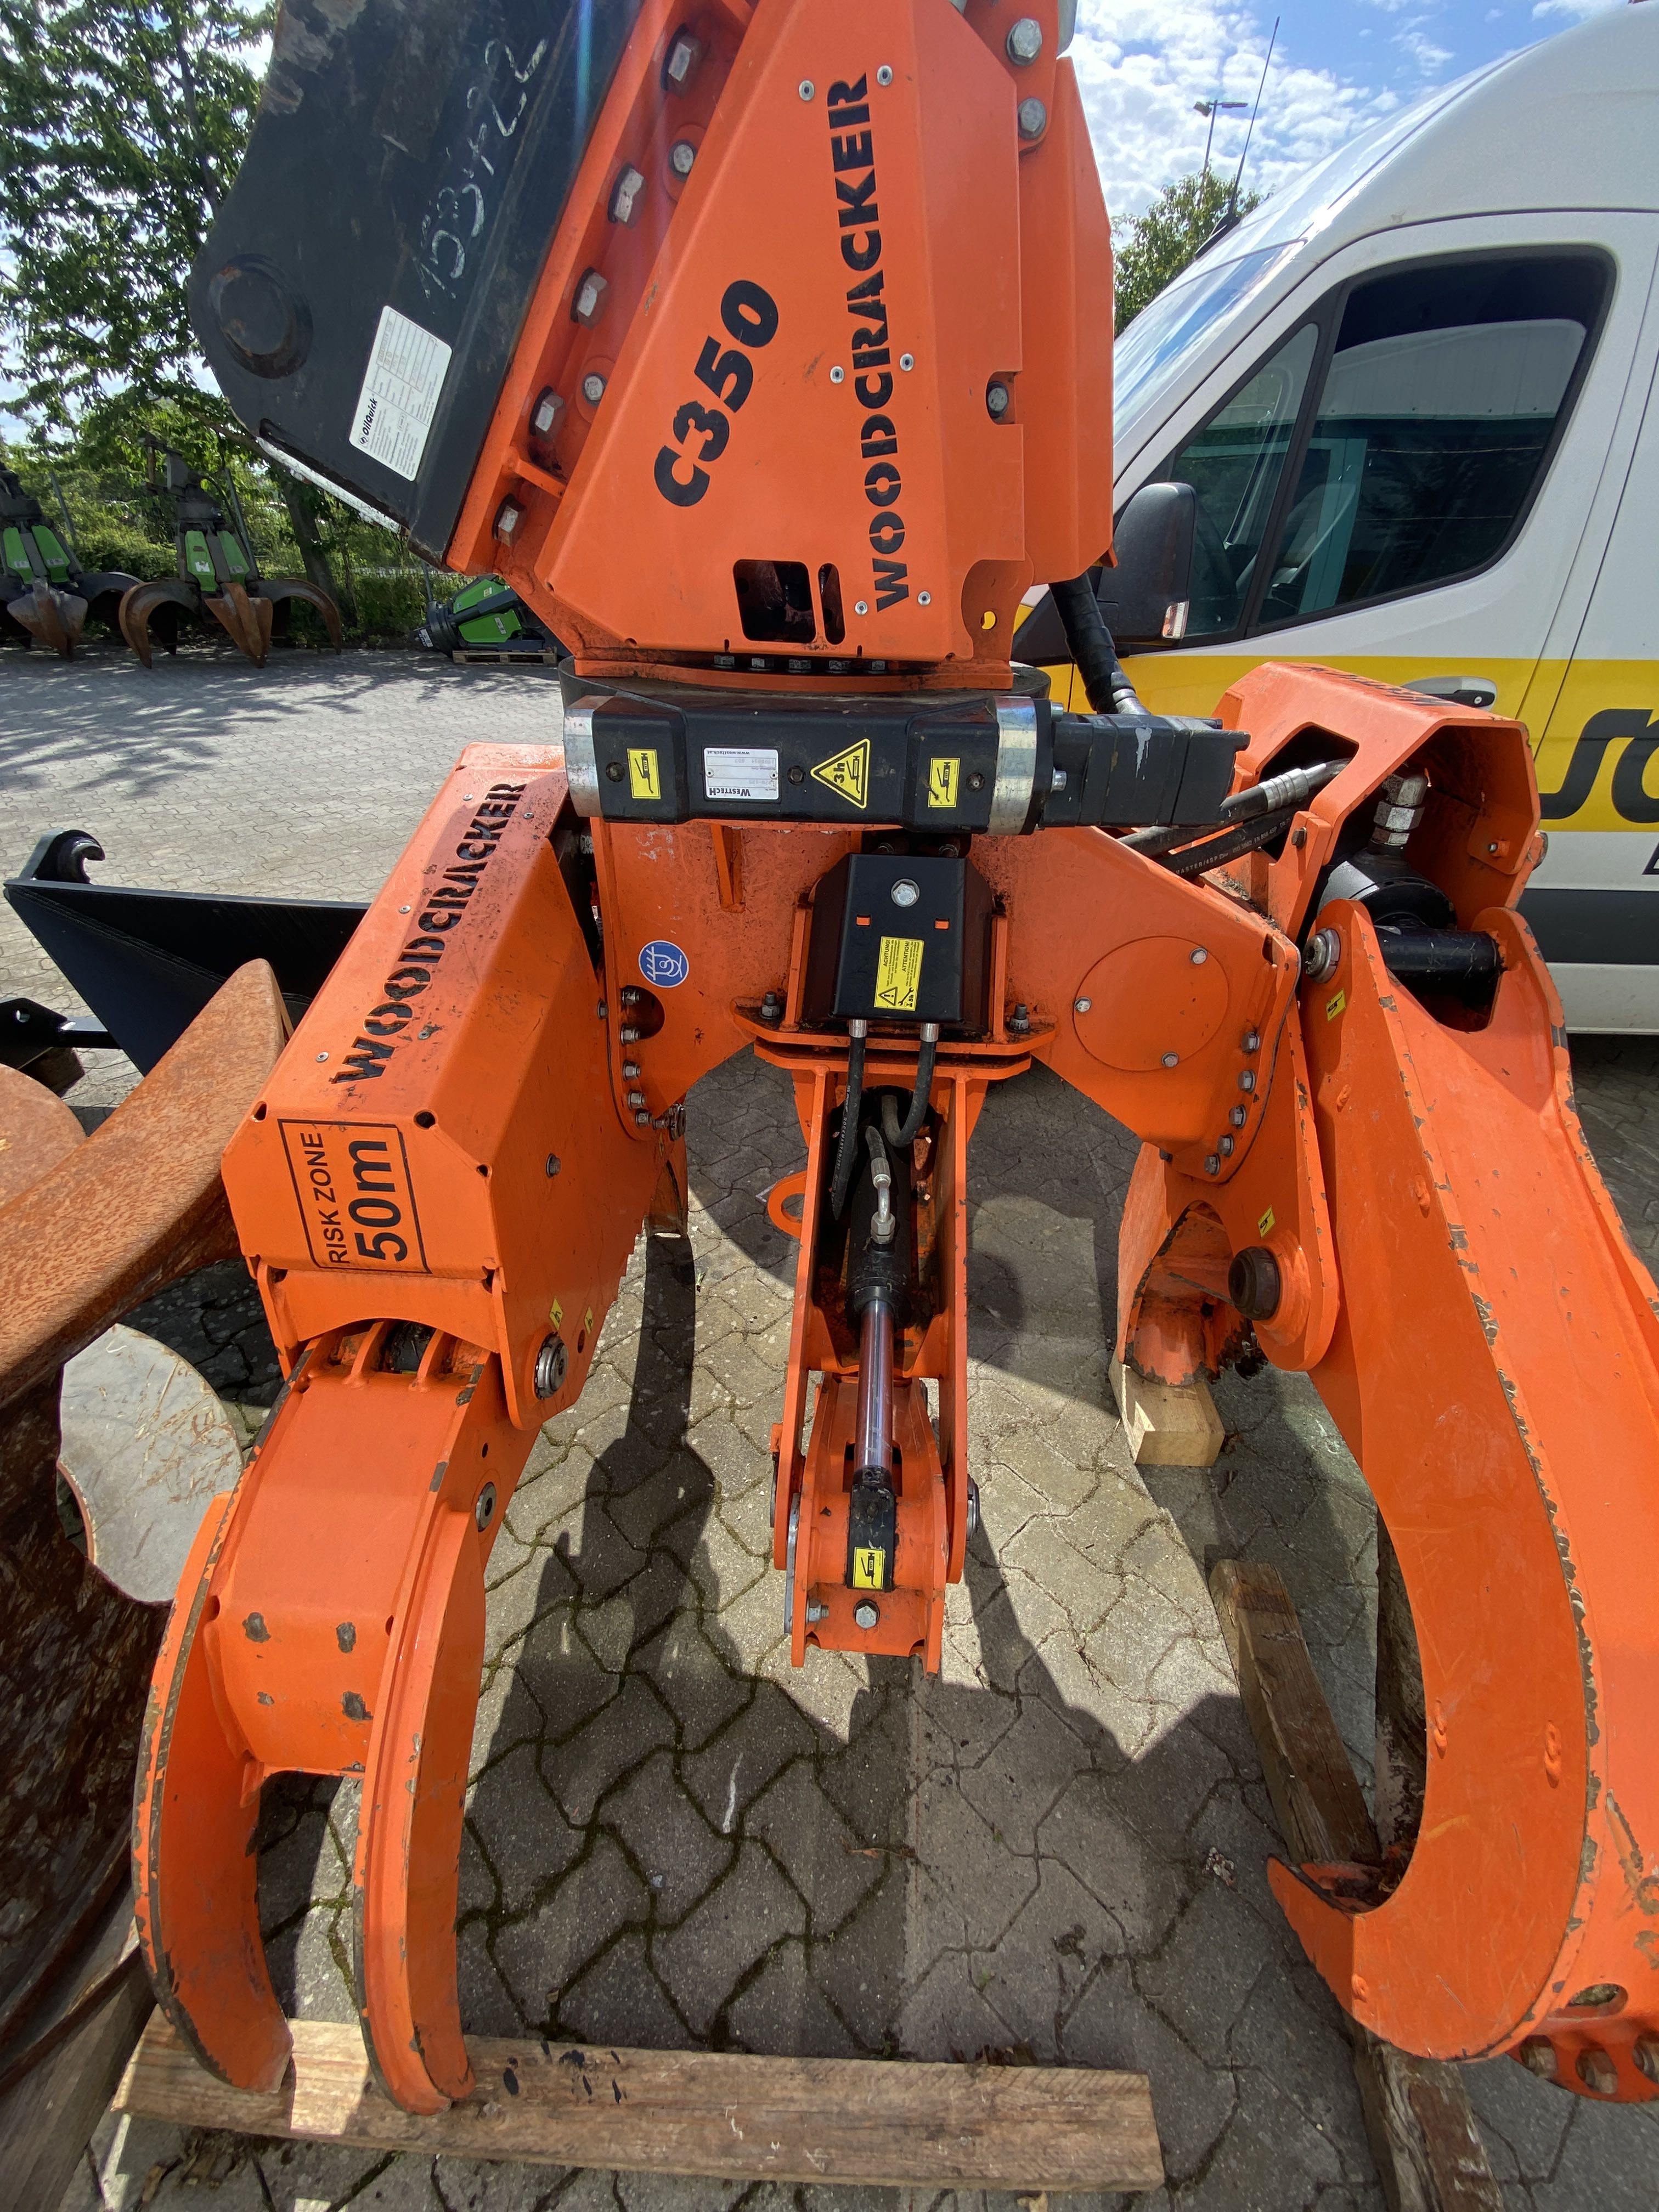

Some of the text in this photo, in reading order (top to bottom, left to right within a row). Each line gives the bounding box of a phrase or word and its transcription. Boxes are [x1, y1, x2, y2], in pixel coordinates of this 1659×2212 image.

[653, 279, 779, 507] C350
[827, 72, 909, 612] WOODCRACKER
[362, 398, 377, 436] OilQuick
[331, 782, 527, 1084] WOODCRACKER
[902, 941, 910, 972] ATTENTION!
[300, 1132, 351, 1265] RISK ZONE
[348, 1141, 408, 1262] 50m
